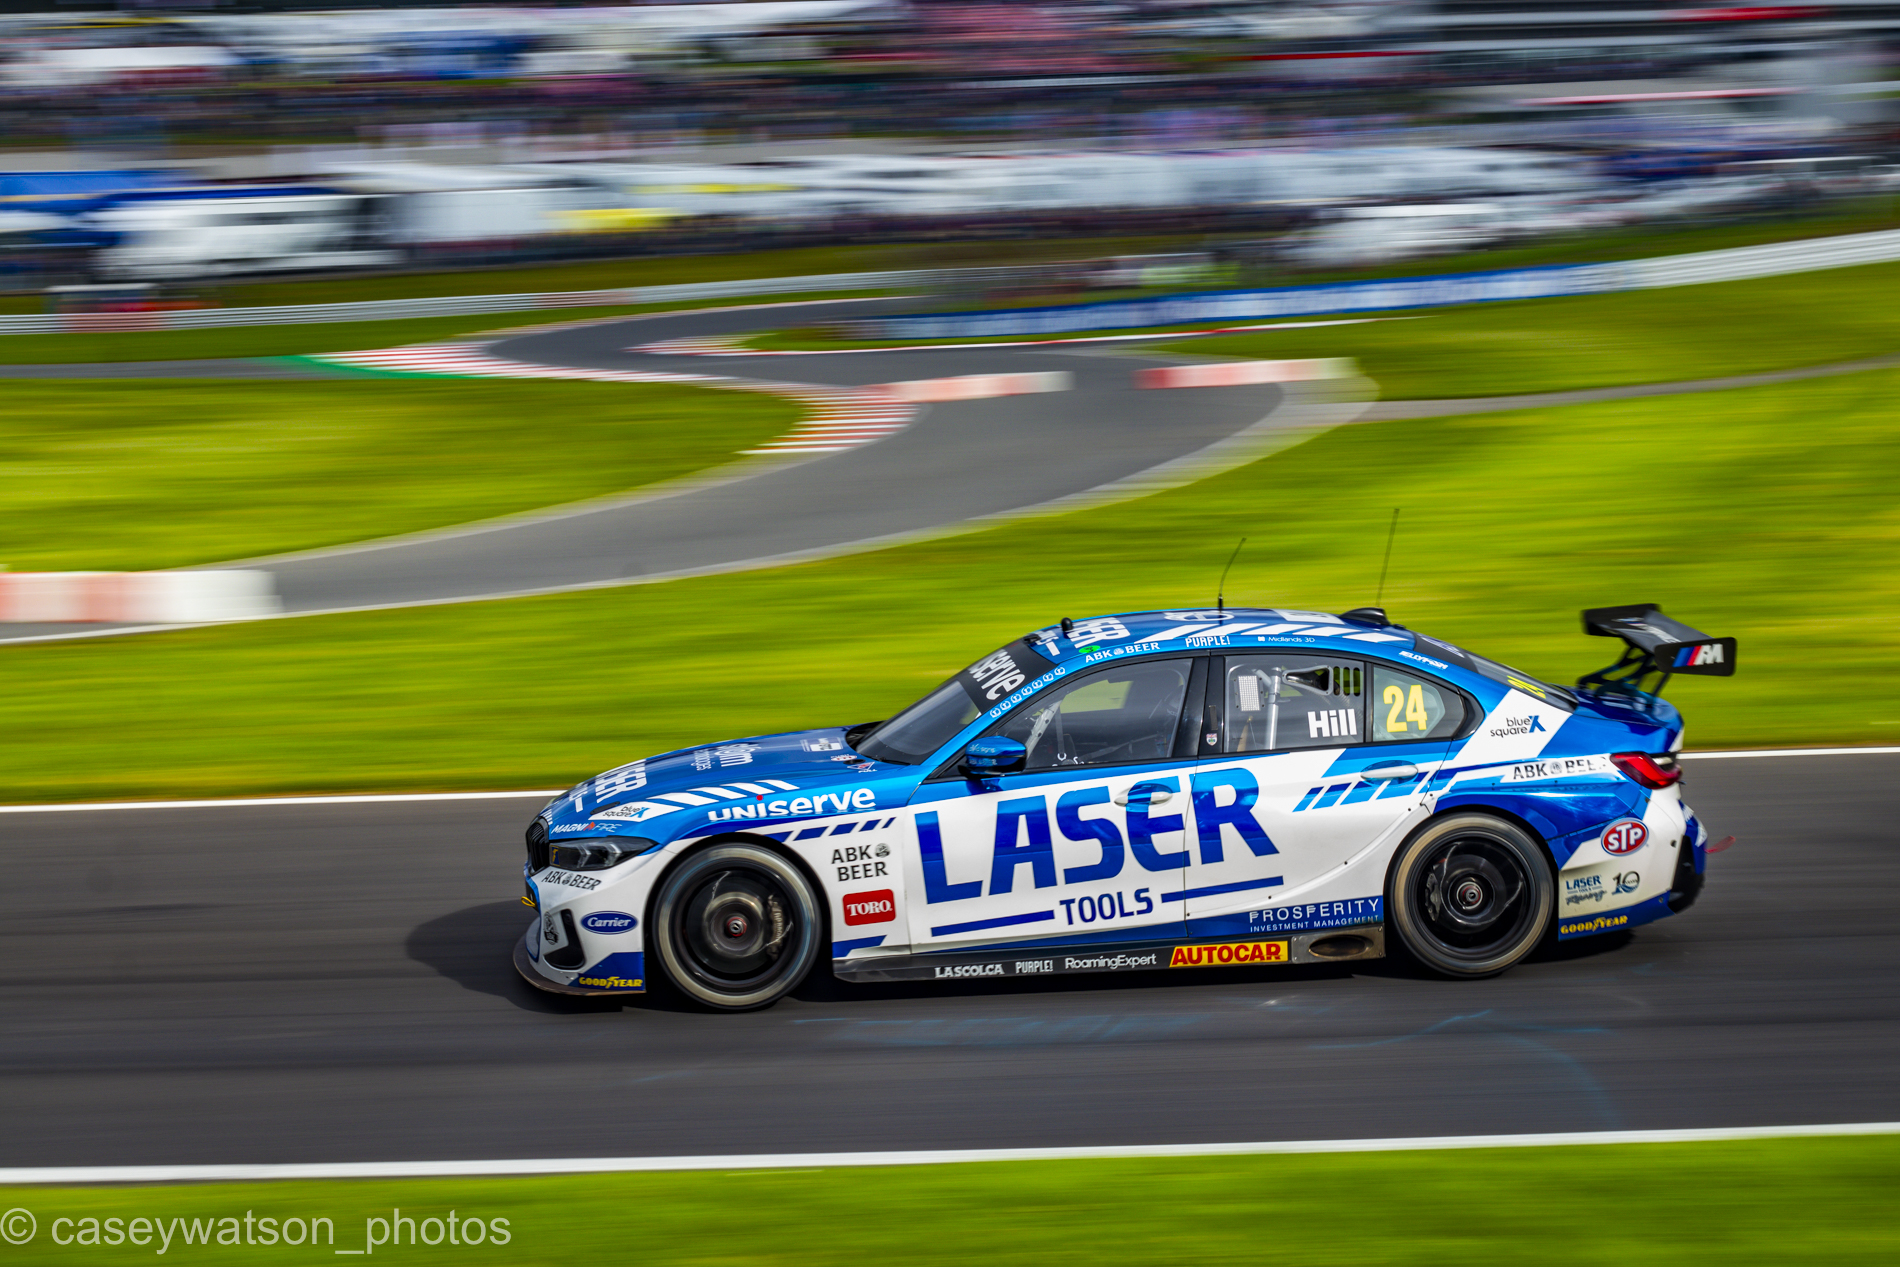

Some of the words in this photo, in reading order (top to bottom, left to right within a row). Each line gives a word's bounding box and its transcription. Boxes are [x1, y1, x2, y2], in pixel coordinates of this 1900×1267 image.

[1185, 635, 1231, 648] PURPLE!
[1085, 649, 1115, 663] ABK
[1124, 642, 1161, 654] BEER
[1383, 684, 1428, 733] 24
[1307, 708, 1358, 738] Hill
[1506, 716, 1531, 727] blue
[1490, 726, 1528, 738] square
[1513, 763, 1548, 780] ABK
[914, 767, 1280, 905] LASER
[1608, 823, 1643, 851] STP
[831, 844, 872, 864] ABK
[541, 871, 567, 883] ABK
[569, 874, 602, 891] BEER
[837, 861, 889, 882] BEER
[1566, 874, 1602, 890] LASER
[847, 899, 892, 916] TORO
[1059, 887, 1154, 926] TOOLS
[1249, 898, 1379, 923] PROSPERITY
[587, 917, 631, 928] Carrier
[1250, 922, 1309, 932] INVESTMENT
[1313, 915, 1379, 928] MANAGEMENT
[1560, 915, 1628, 934] GOODYEAR
[1065, 954, 1156, 970] RoamingExpert
[1171, 943, 1282, 966] AUTOCAR
[1015, 960, 1054, 974] PURPLE!
[579, 976, 643, 989] GOODYEAR
